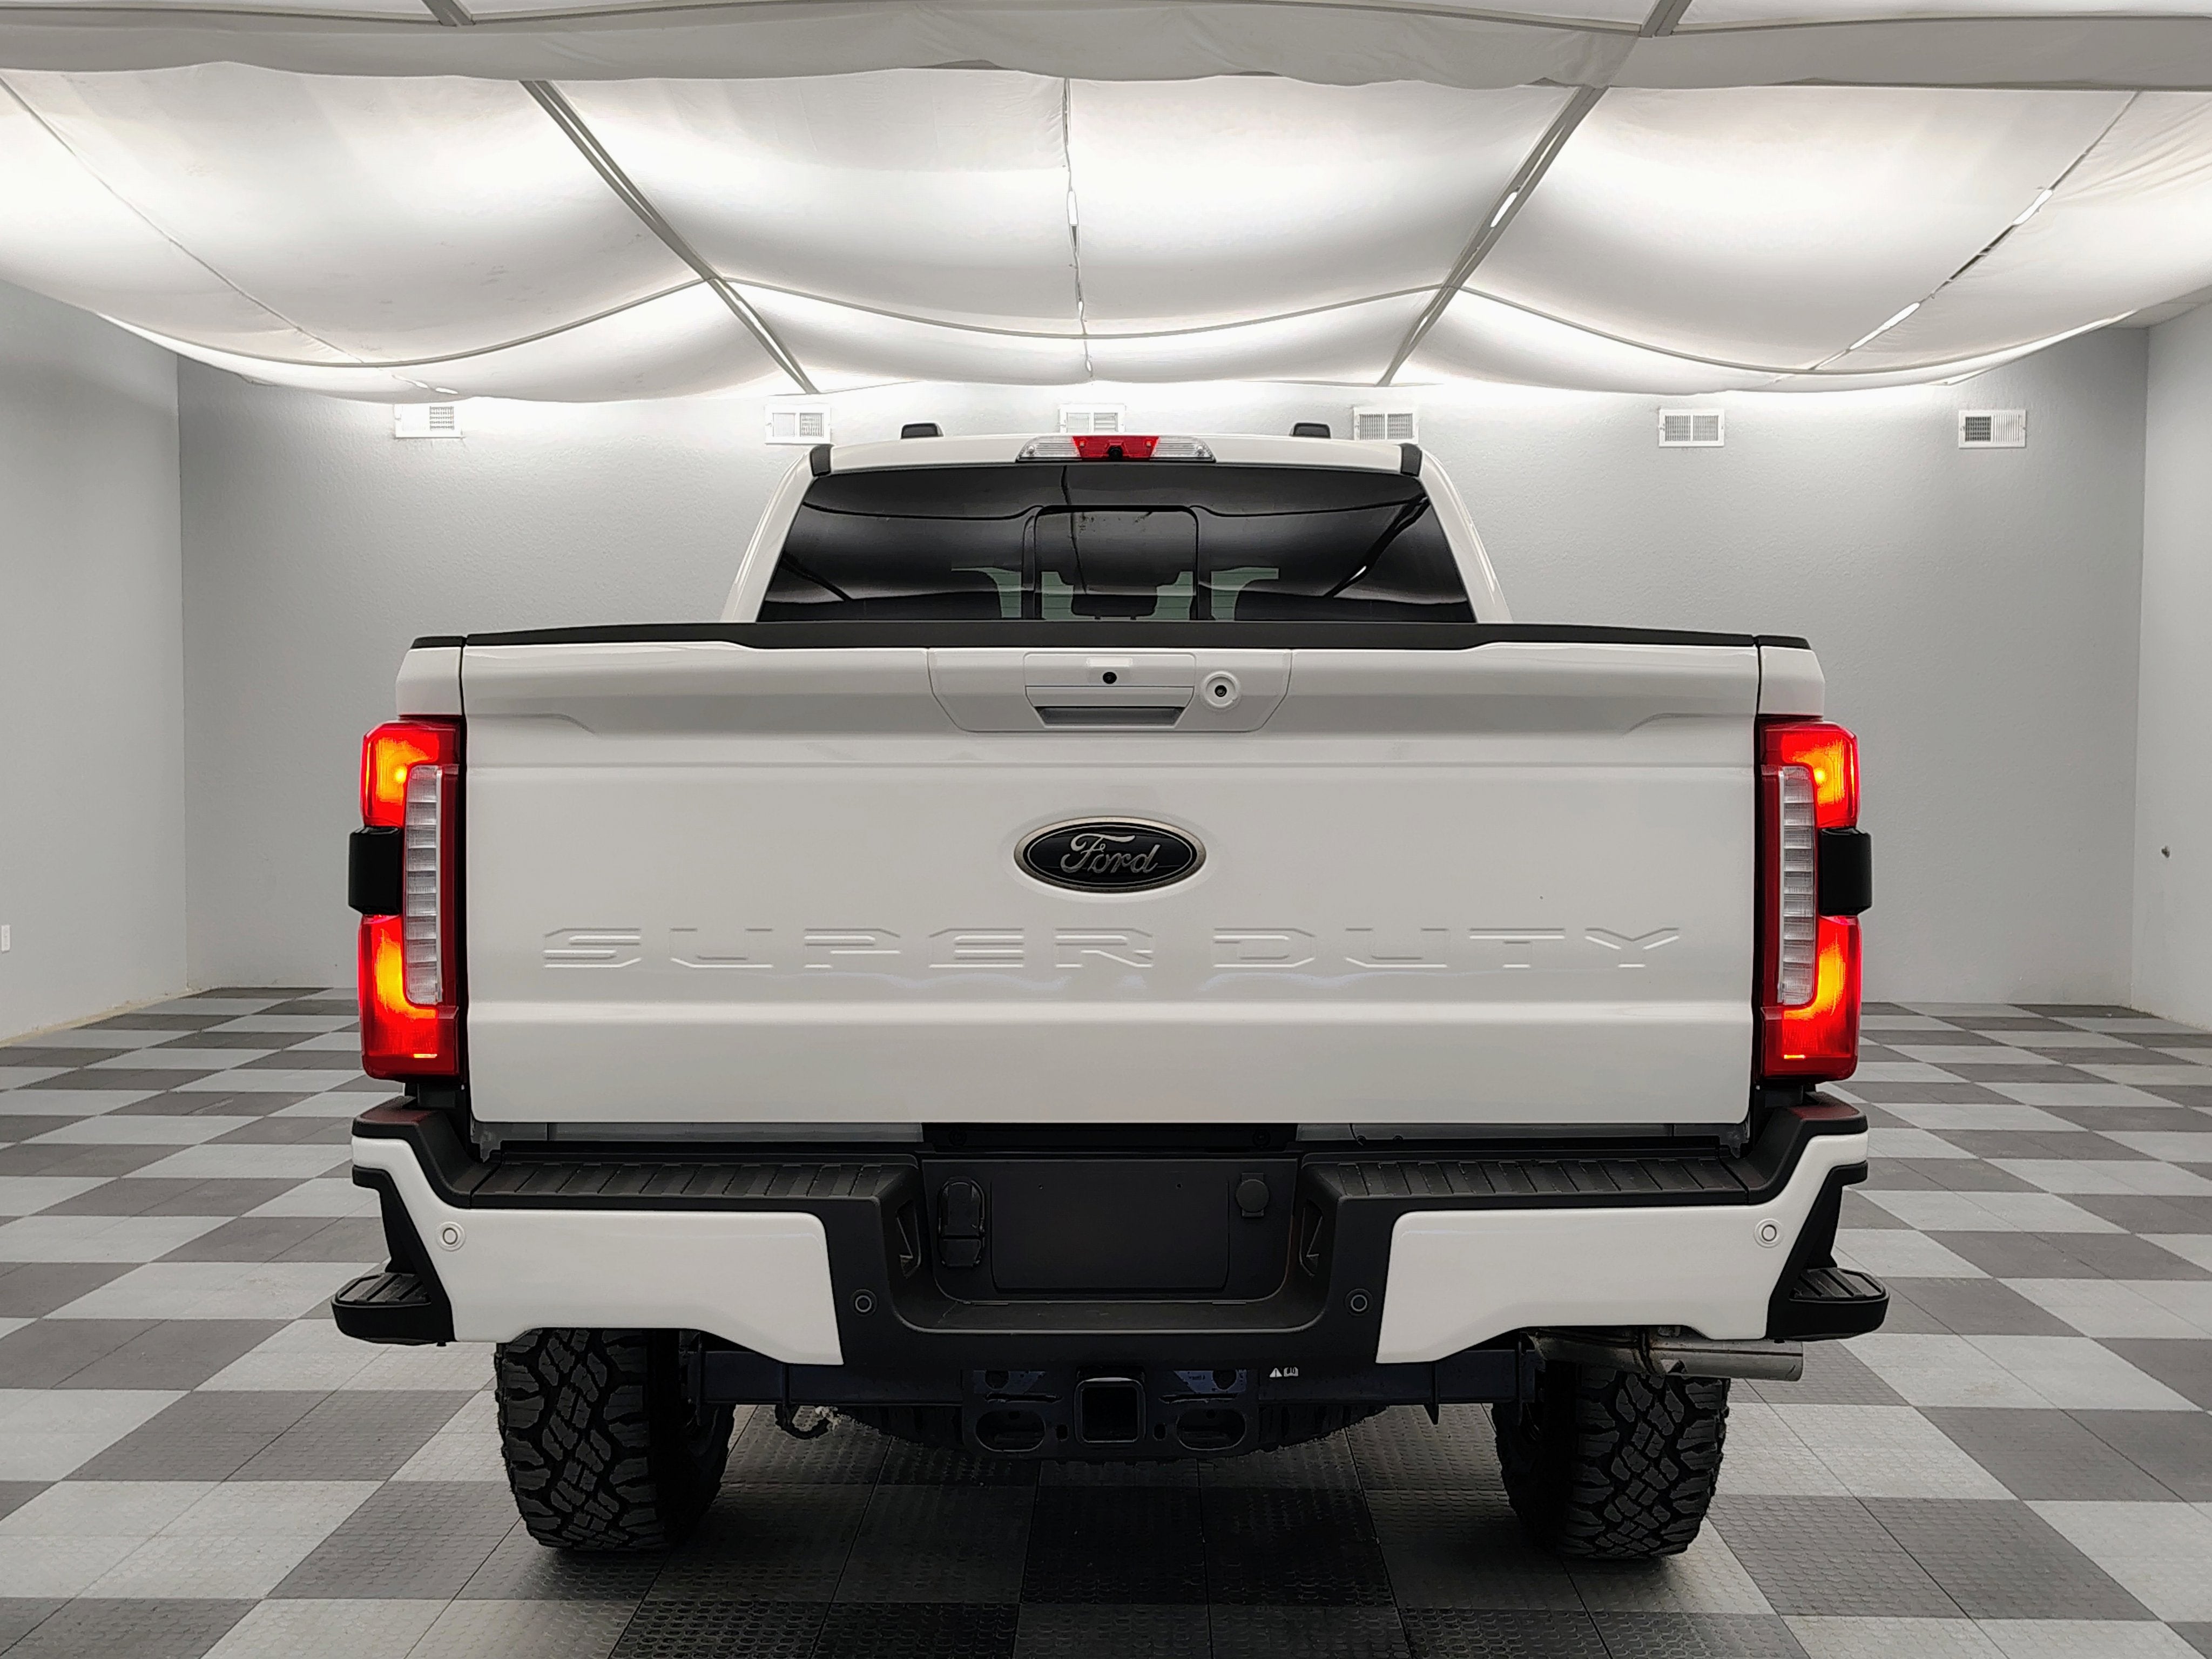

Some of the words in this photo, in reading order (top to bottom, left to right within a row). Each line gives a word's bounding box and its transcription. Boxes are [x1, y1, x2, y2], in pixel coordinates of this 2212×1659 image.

[1060, 833, 1159, 874] Ford
[542, 927, 1154, 968] SUPER
[1213, 927, 1680, 968] DUTY
